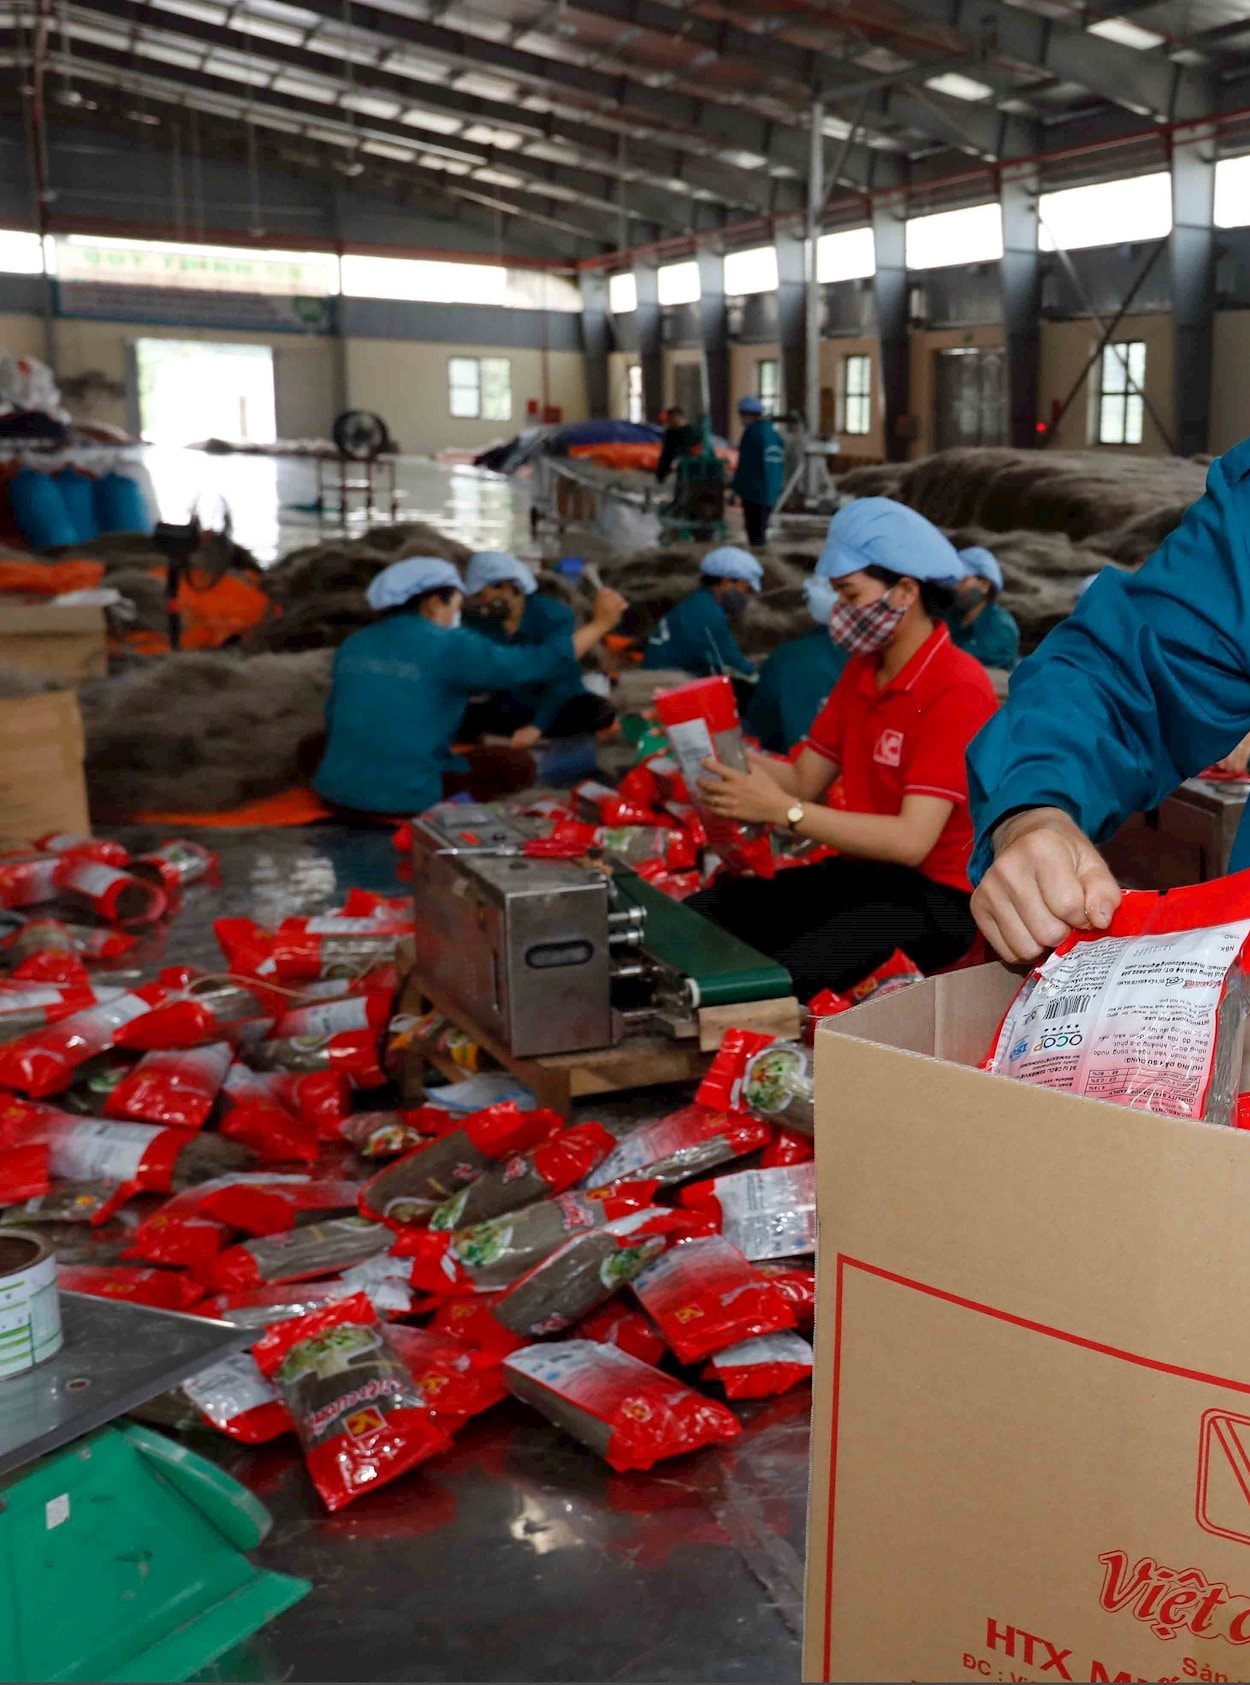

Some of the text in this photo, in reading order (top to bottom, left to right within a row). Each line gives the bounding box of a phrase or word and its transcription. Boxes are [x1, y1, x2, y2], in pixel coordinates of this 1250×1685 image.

[1033, 1034, 1082, 1052] OCOP
[1099, 1550, 1228, 1641] Việt
[986, 1617, 1073, 1682] HTX
